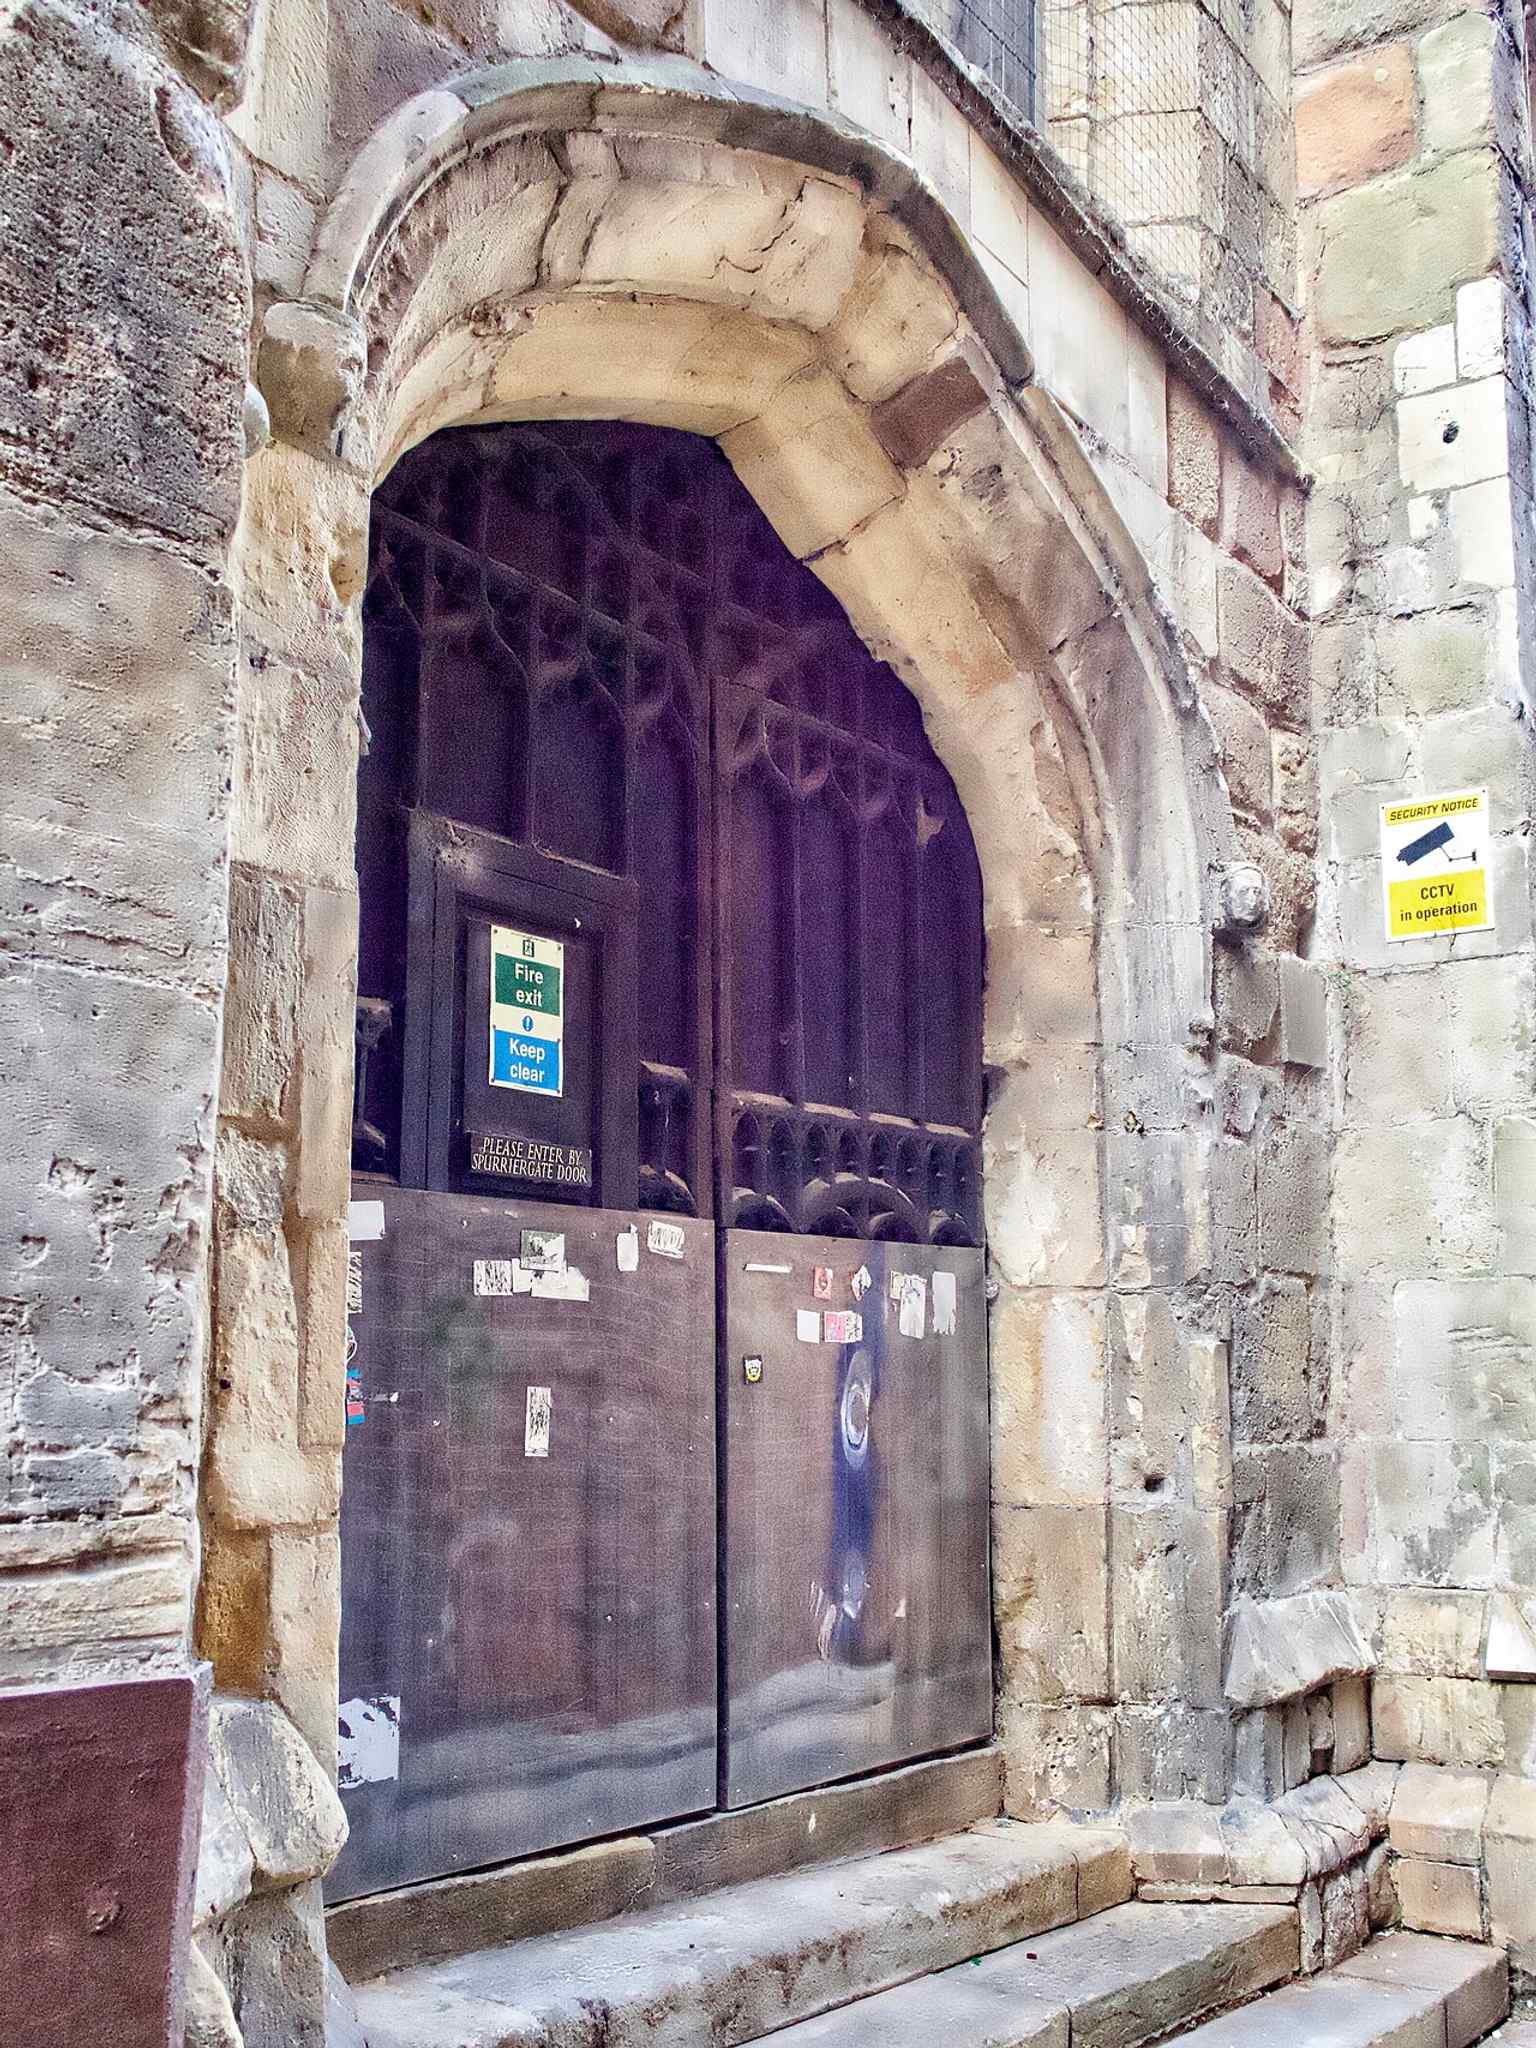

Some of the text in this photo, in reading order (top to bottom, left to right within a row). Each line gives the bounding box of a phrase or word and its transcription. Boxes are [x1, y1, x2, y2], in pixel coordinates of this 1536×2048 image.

[1389, 797, 1478, 821] SECURITY NOTICE
[1420, 883, 1455, 900] CCTV
[1400, 901, 1478, 922] in operation
[514, 962, 544, 985] Fire
[515, 988, 543, 1007] exit
[509, 1037, 546, 1063] Keep
[510, 1062, 545, 1083] clear
[483, 1136, 524, 1158] PLEASE
[527, 1143, 564, 1164] ENTER
[471, 1153, 588, 1184] SPURRIERGATE DOOR
